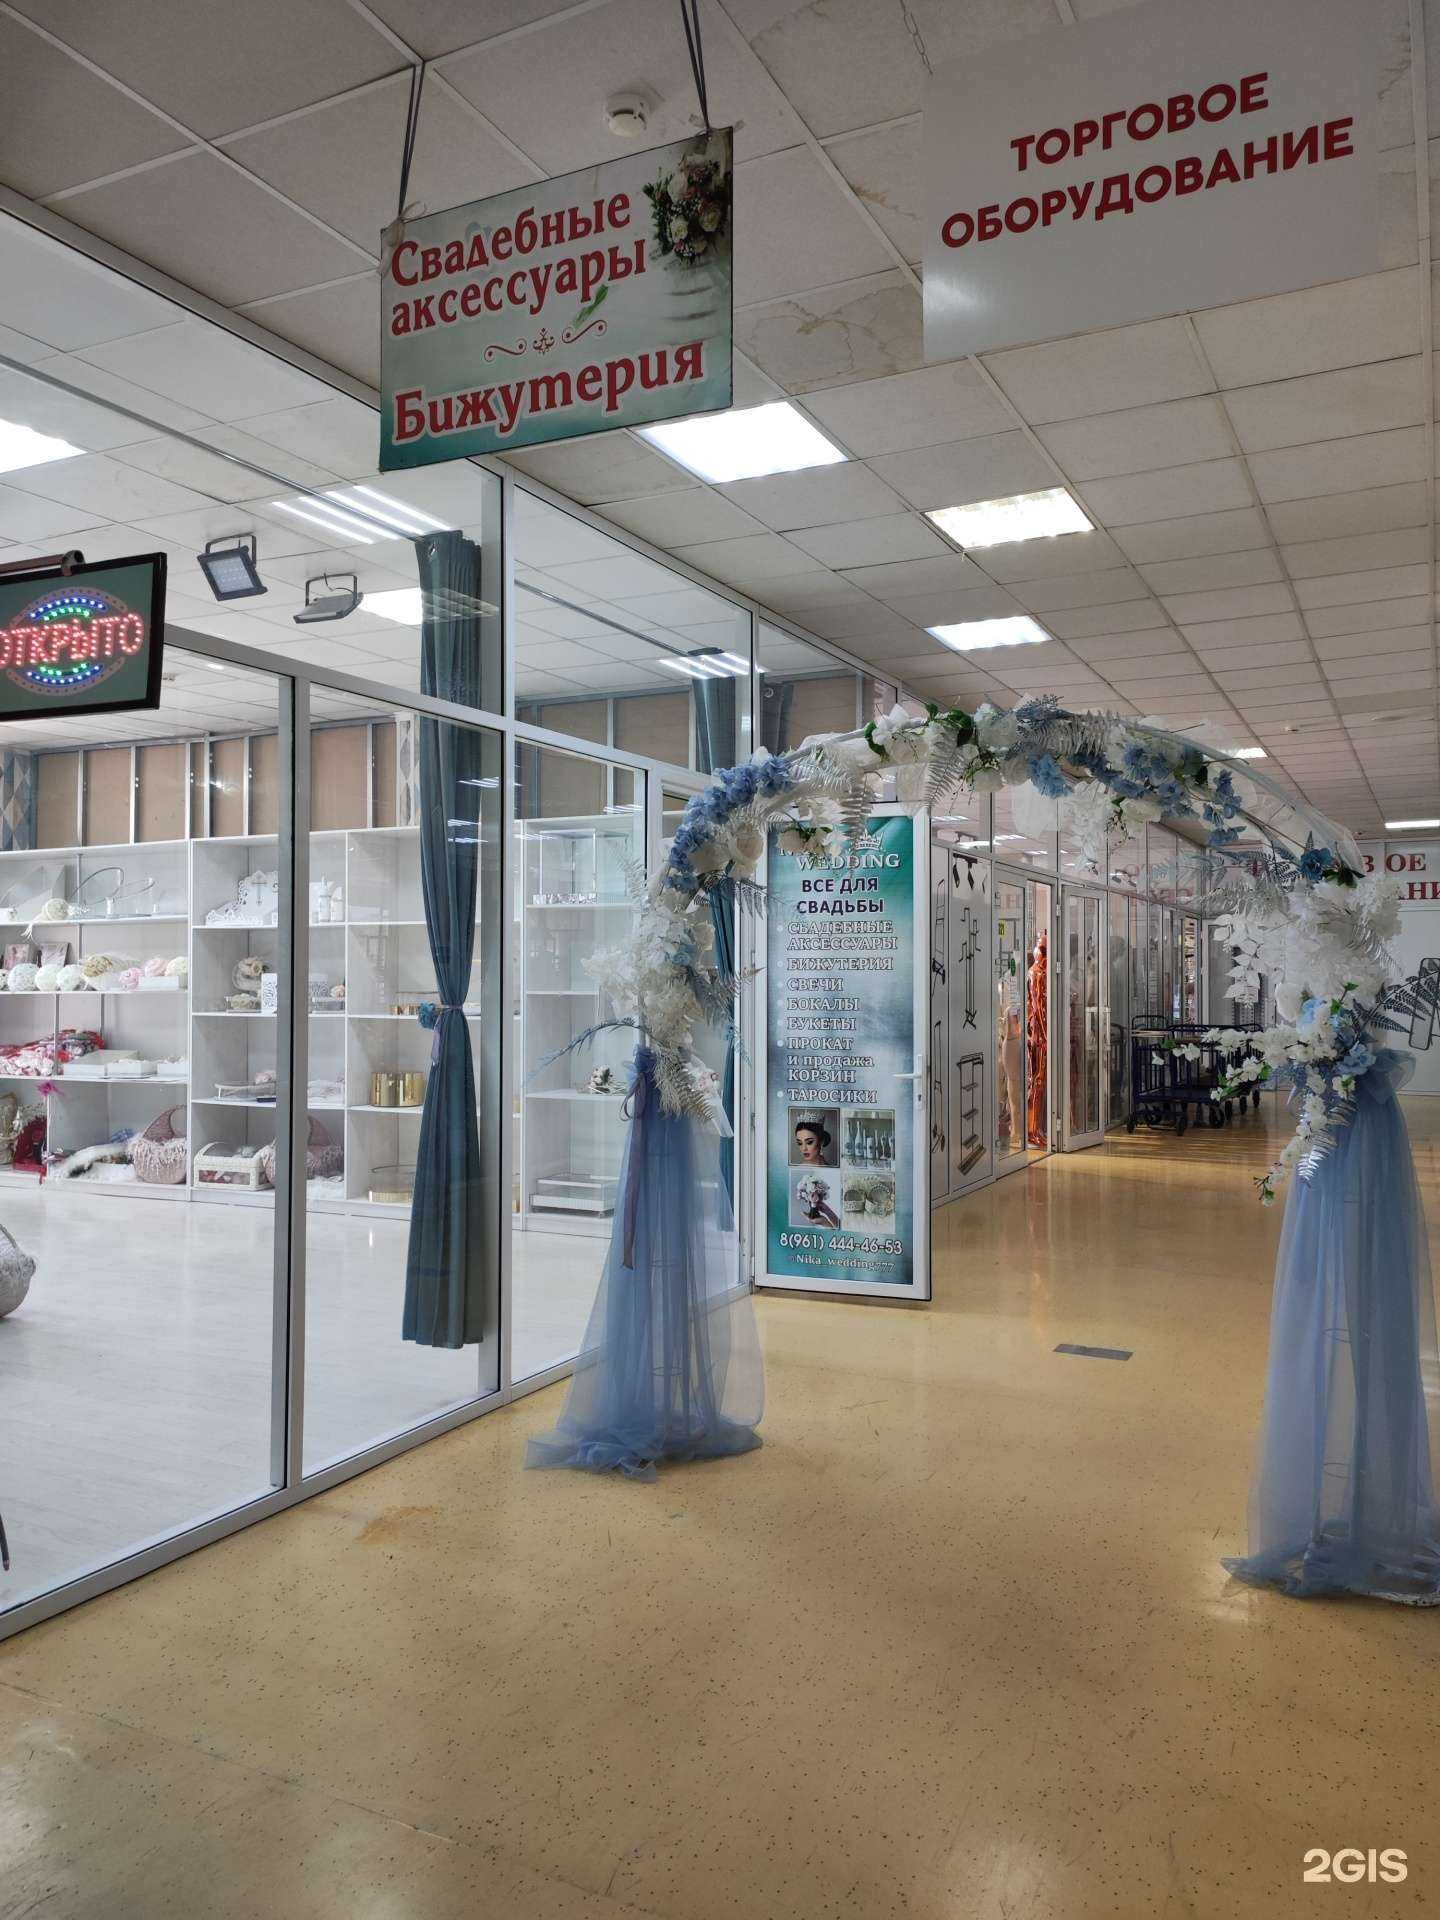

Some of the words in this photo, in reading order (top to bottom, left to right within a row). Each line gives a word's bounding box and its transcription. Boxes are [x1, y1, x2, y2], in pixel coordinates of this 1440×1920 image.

[1010, 72, 1269, 172] ТОРГОВОЕ
[941, 117, 1354, 248] ОБОРУДОВАНИЕ
[391, 192, 631, 287] Свадебные
[391, 239, 647, 336] аксессуары
[394, 342, 704, 441] Бижутерия
[796, 853, 901, 871] WEDDING
[802, 878, 834, 893] ВСЕ
[840, 877, 878, 894] ДЛЯ
[797, 899, 884, 915] СВАДЬБЫ
[787, 937, 898, 951] АКСЕССУАРЫ
[787, 957, 894, 971] БИЖУТЕРИЯ
[787, 978, 844, 991] СВЕЧИ
[787, 998, 860, 1011] БОКАЛЫ
[787, 1017, 857, 1030] БУКЕТЫ
[787, 1037, 854, 1050] ПРОКАТ
[787, 1055, 798, 1065] и
[803, 1055, 875, 1068] продажа
[787, 1069, 857, 1083] КОРЗИН
[787, 1088, 878, 1103] ТАРОСИКИ
[780, 1233, 825, 1250] 8(961)
[828, 1236, 903, 1255] 444-46-53
